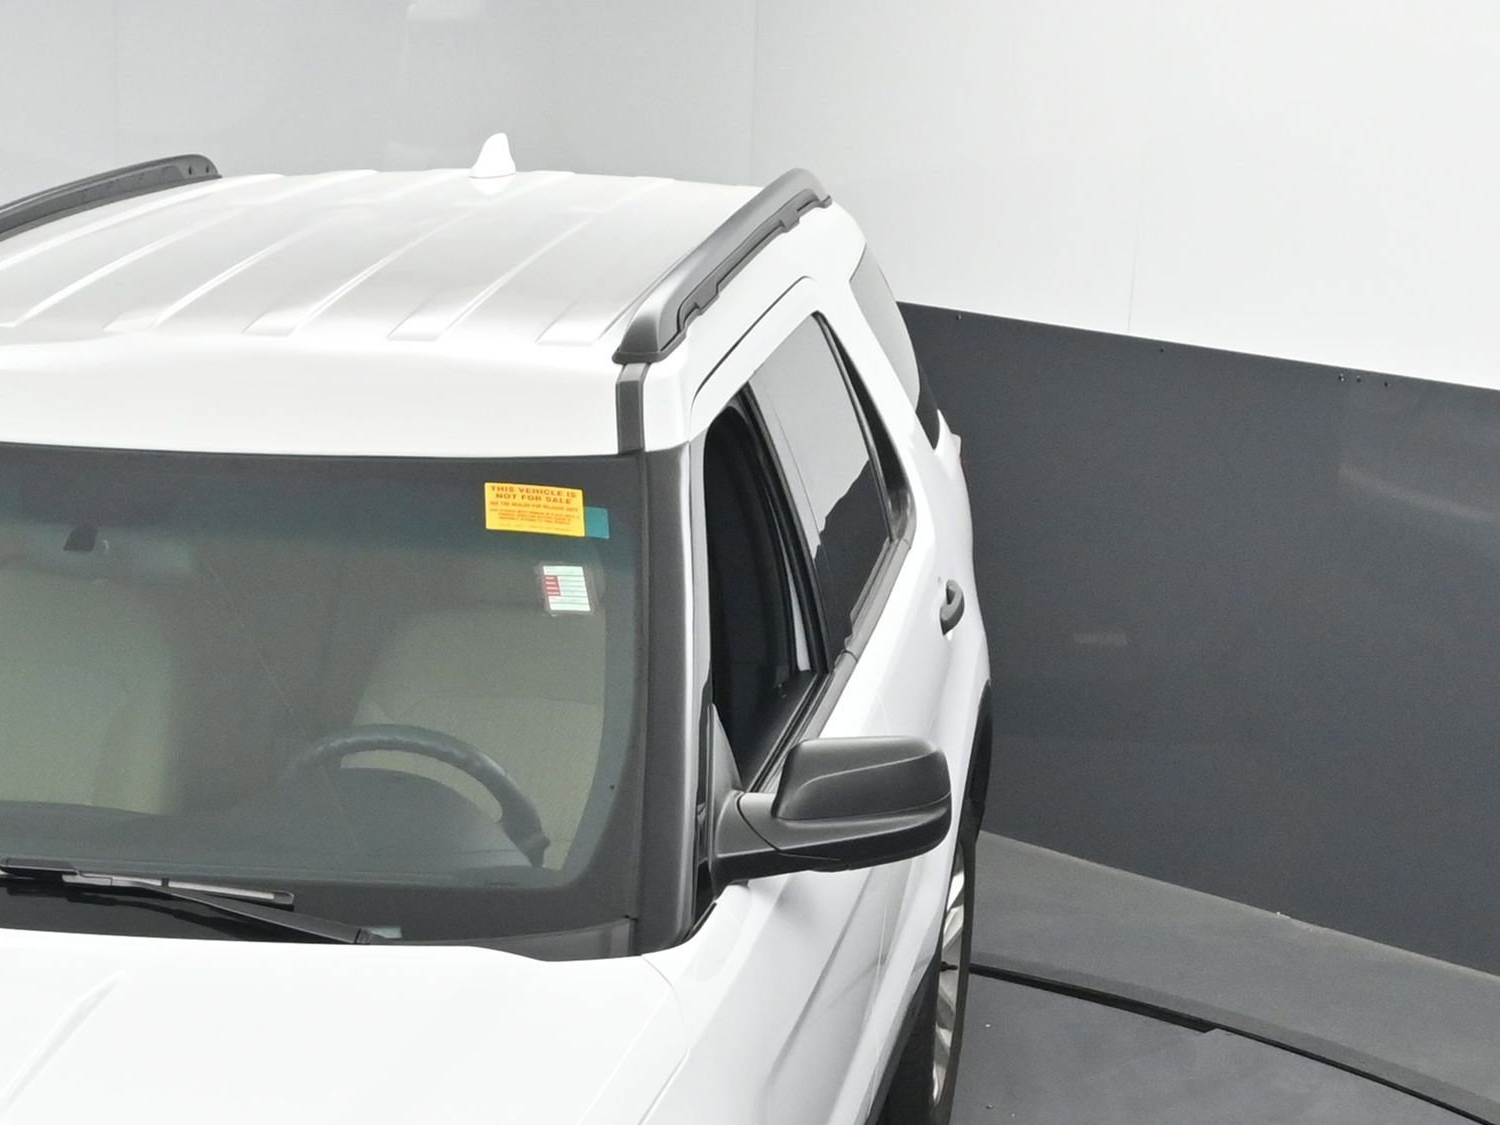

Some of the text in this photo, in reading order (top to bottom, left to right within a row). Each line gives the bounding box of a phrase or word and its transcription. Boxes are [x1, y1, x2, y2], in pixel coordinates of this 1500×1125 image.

[491, 485, 515, 493] THIS
[518, 487, 564, 496] VEHICLE
[545, 496, 572, 504] SALE
